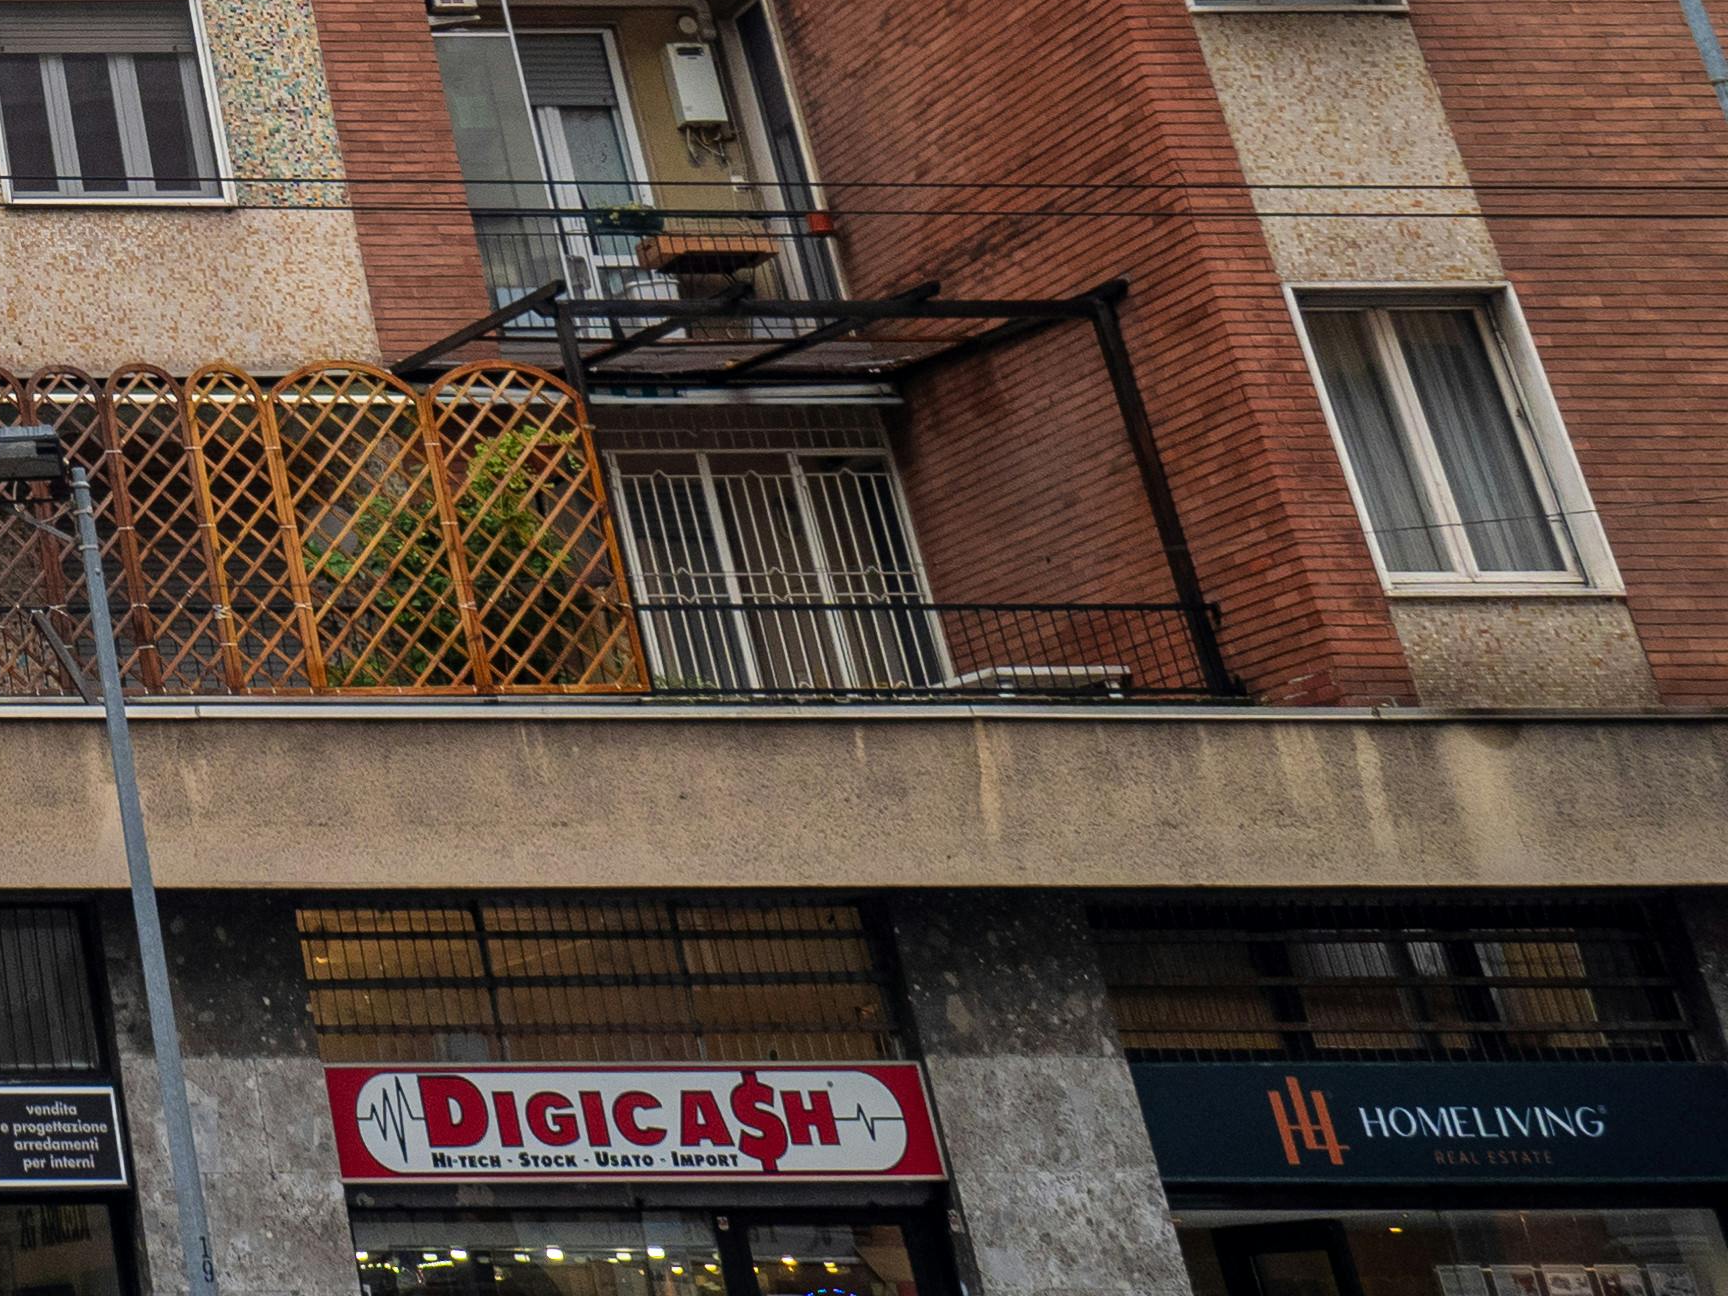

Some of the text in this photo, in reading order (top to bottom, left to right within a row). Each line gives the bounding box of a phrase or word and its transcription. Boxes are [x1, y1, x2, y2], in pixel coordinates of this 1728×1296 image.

[25, 1101, 78, 1116] vendita
[0, 1119, 108, 1137] e progettazione
[1358, 1106, 1606, 1139] HOMELIVING
[14, 1136, 100, 1151] arredamenti
[23, 1154, 96, 1173] per interni
[1434, 1151, 1554, 1165] REAL ESTATE
